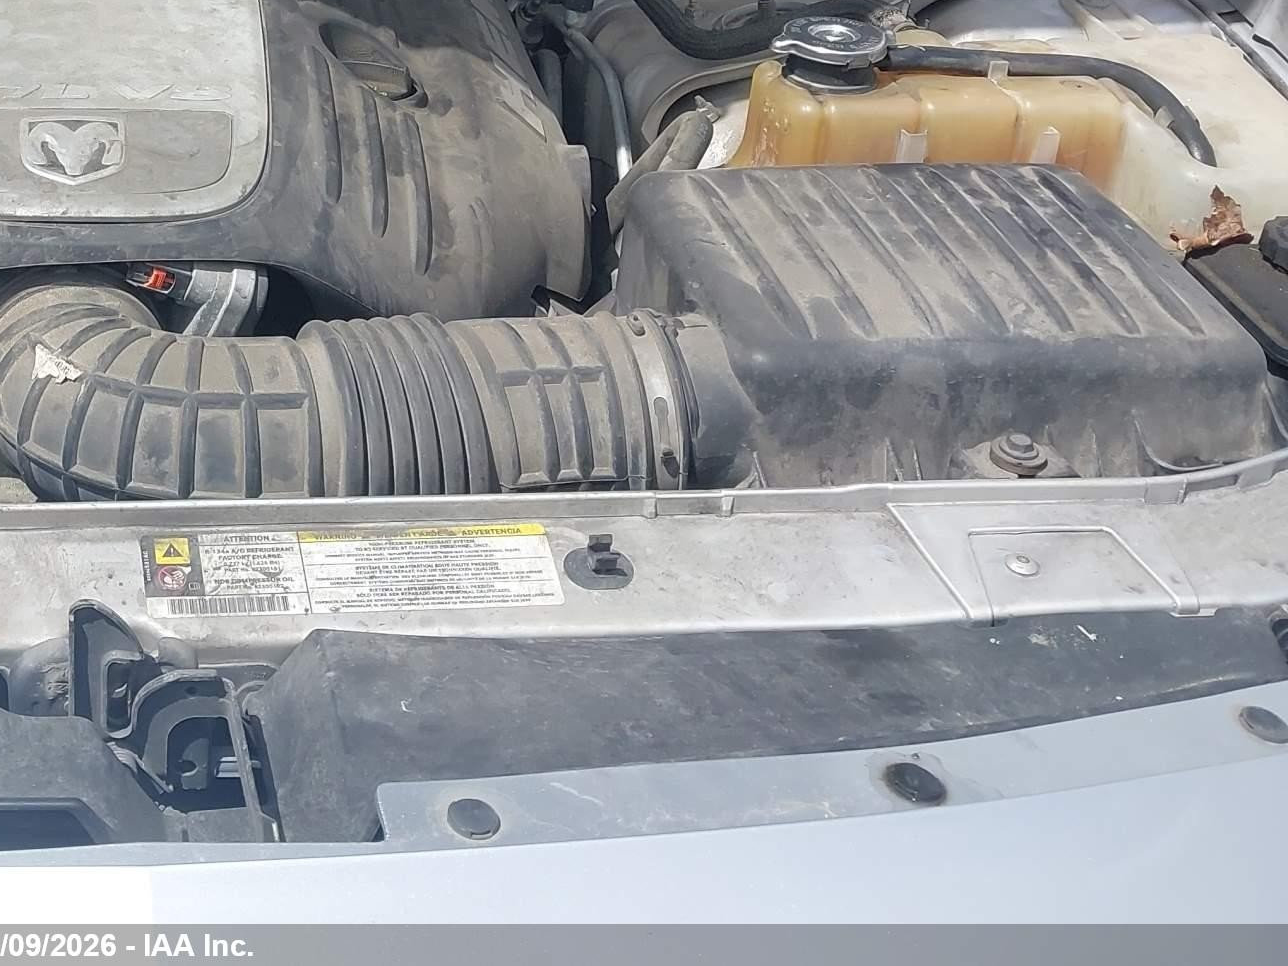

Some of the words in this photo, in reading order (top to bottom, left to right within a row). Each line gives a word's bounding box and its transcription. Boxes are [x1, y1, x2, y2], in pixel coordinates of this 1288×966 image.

[113, 83, 233, 101] V8
[462, 528, 522, 536] ADVERTENCIA
[224, 535, 270, 543] ATTENTION
[246, 546, 294, 554] REFRIGERANT
